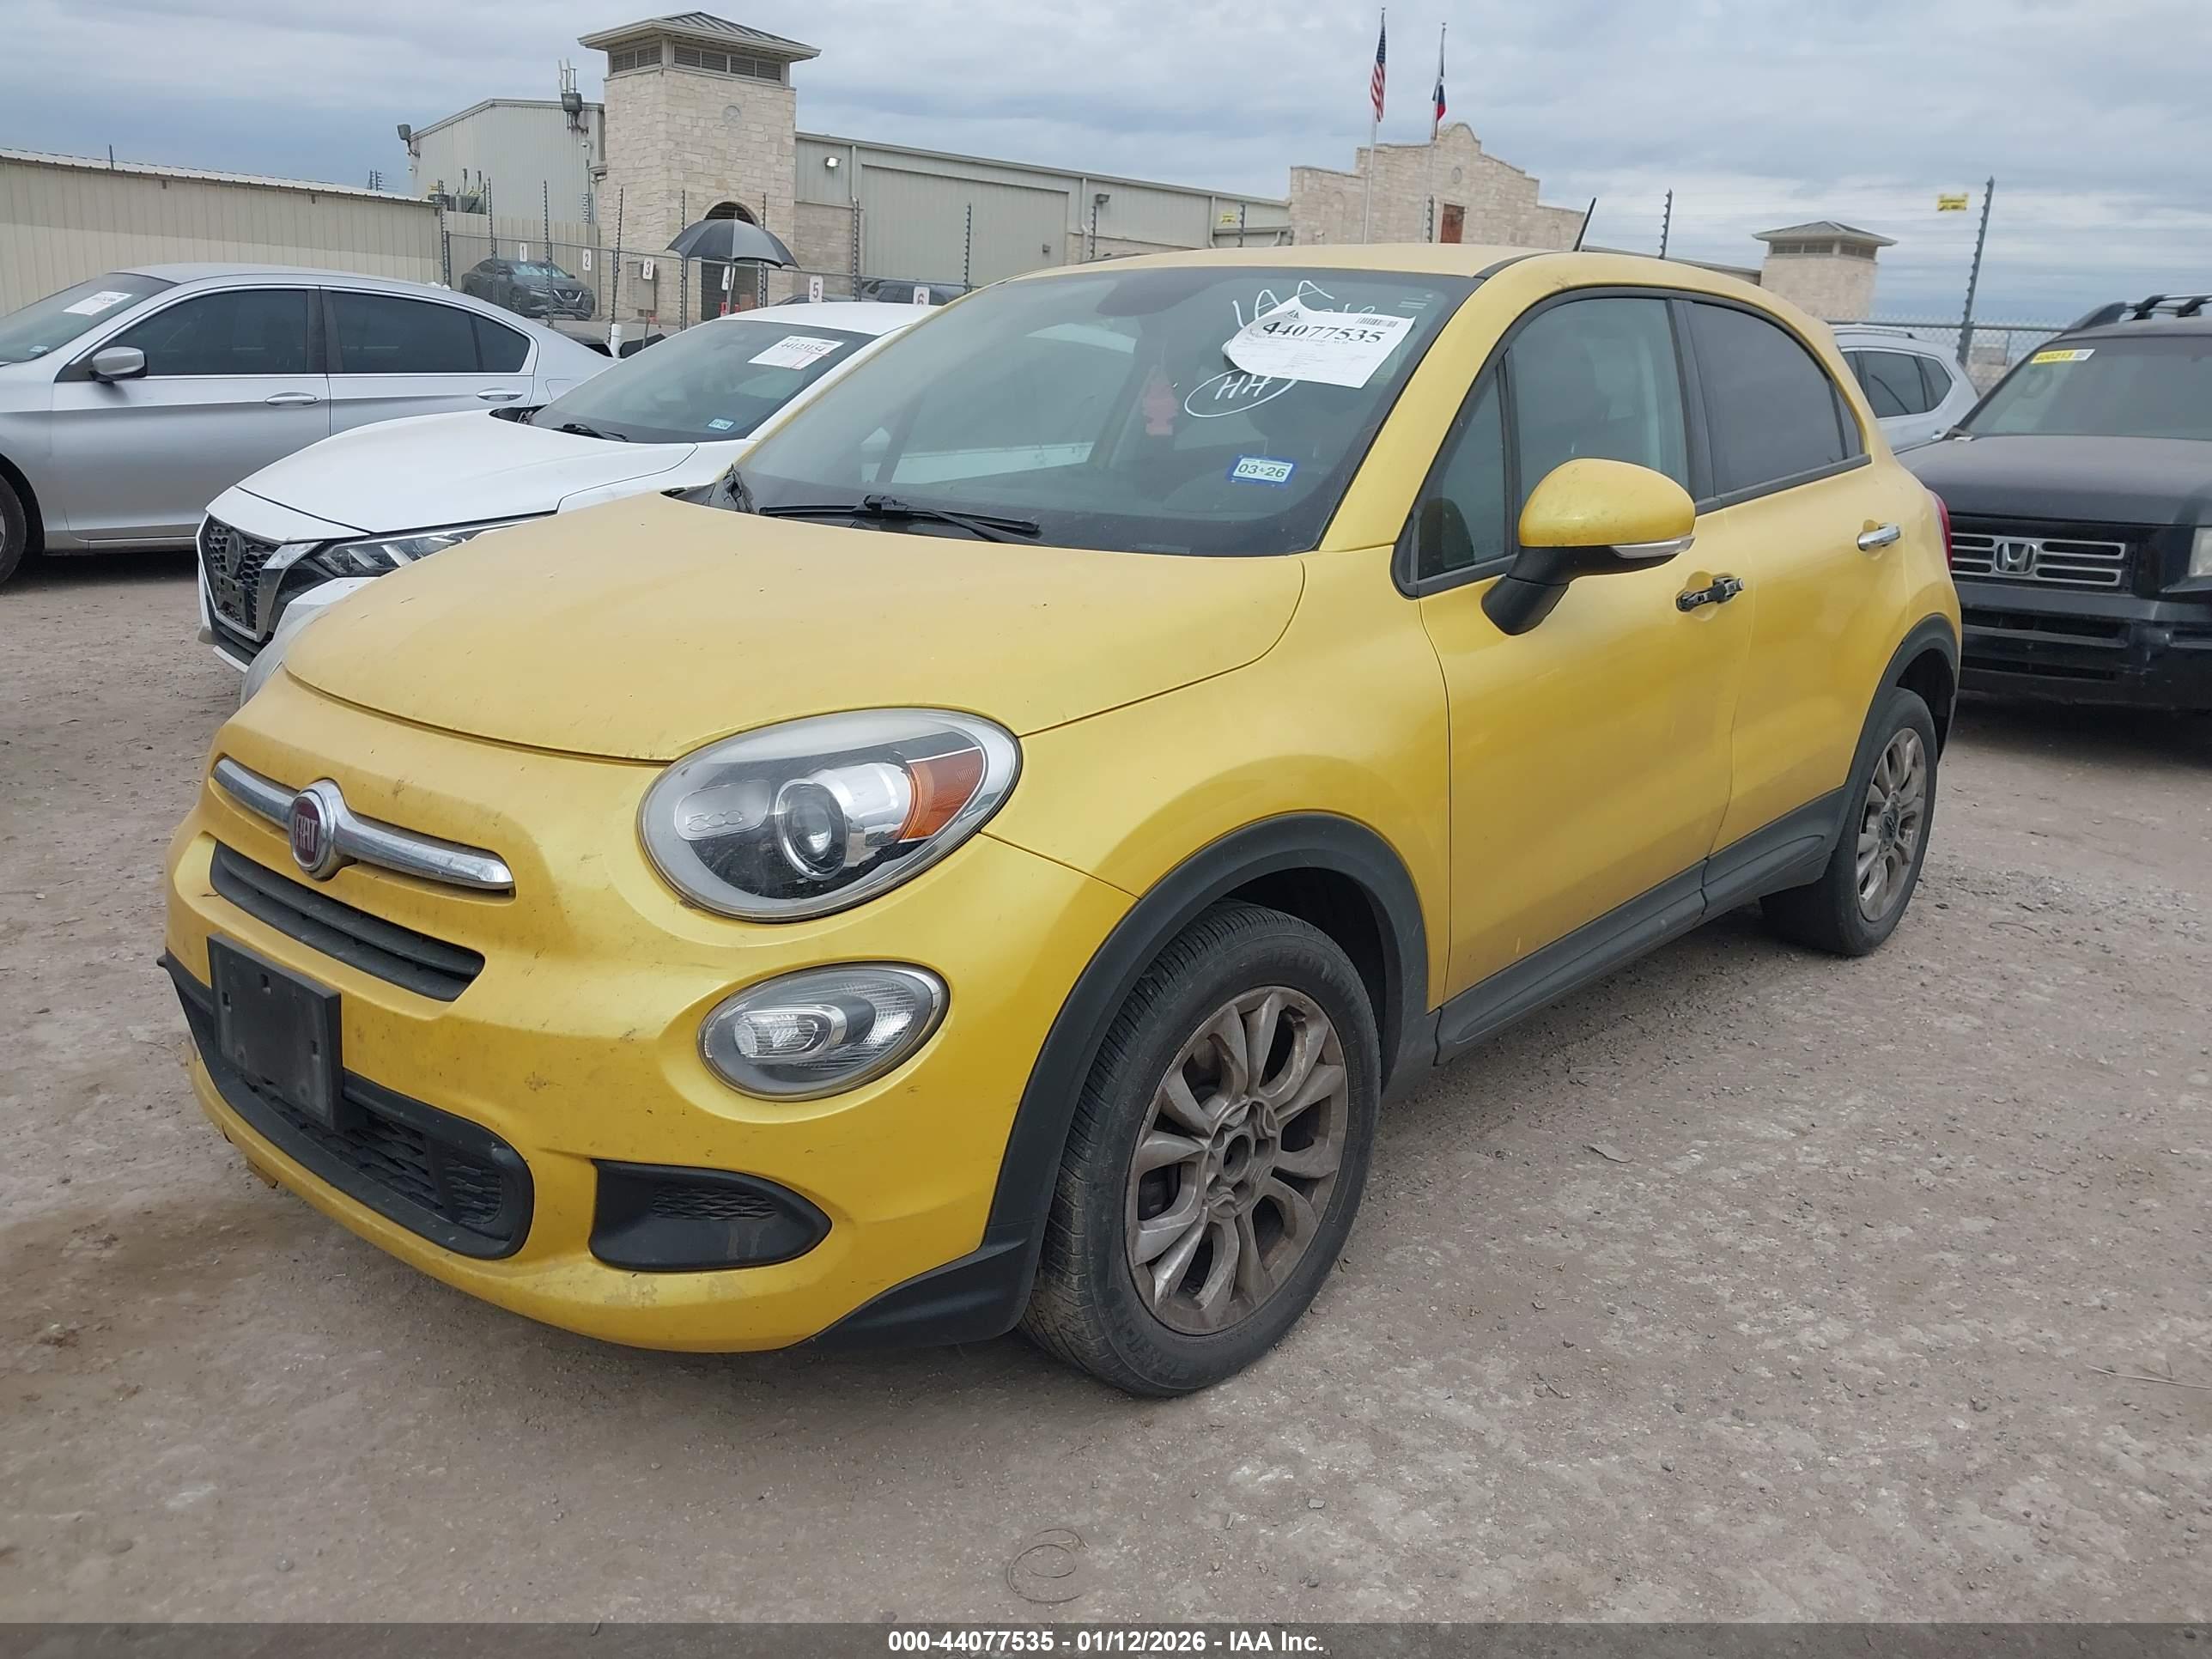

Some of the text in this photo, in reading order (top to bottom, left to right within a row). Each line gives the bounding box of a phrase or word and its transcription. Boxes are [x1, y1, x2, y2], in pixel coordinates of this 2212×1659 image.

[585, 253, 590, 267] 2
[645, 260, 652, 276] 3
[812, 281, 819, 299] 5
[1262, 321, 1388, 343] 44077535
[1237, 464, 1287, 478] 03 26
[295, 813, 319, 853] FIAT
